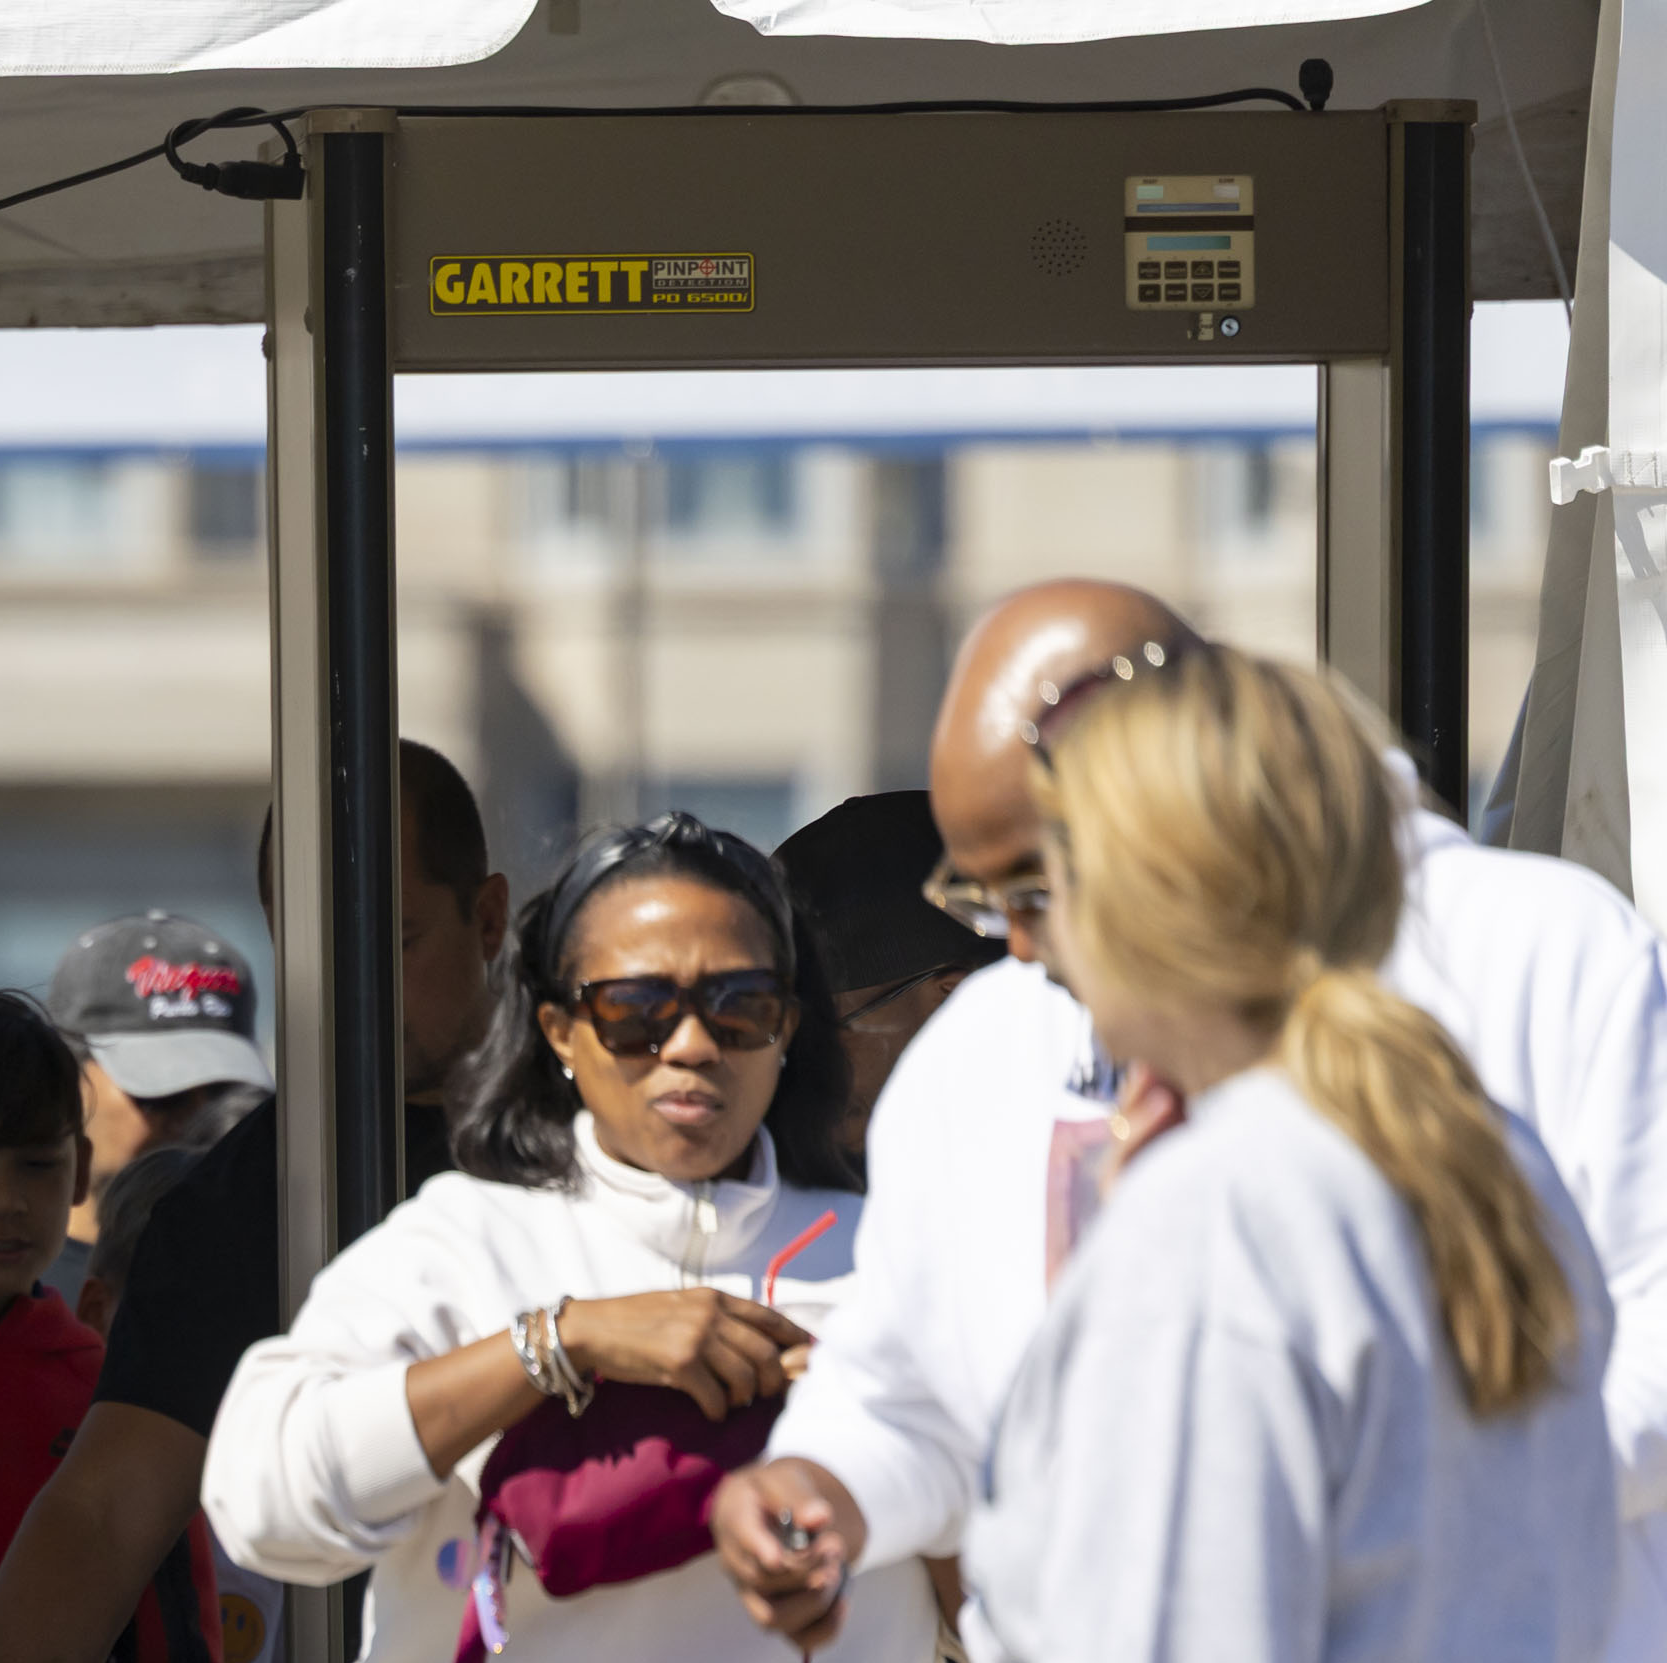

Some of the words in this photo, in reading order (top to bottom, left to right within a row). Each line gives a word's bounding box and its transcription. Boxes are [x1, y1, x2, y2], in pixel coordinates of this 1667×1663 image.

[435, 261, 648, 304] GARRETT
[657, 279, 745, 287] DETECTION
[687, 292, 747, 302] 6500i
